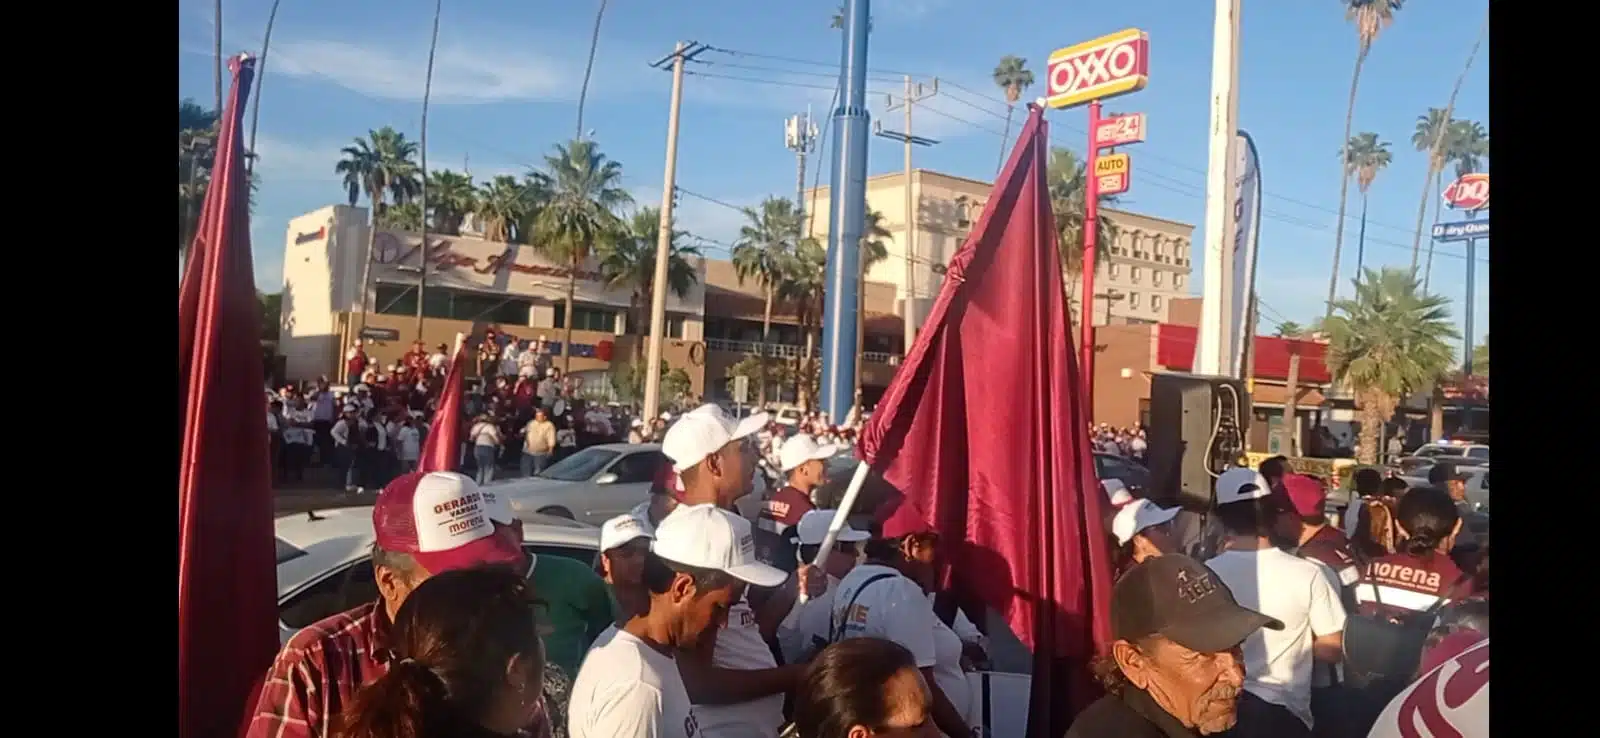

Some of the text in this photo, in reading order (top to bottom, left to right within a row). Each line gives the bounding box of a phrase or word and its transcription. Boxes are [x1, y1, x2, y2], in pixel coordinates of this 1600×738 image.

[1049, 43, 1136, 94] OXXO
[1116, 118, 1138, 134] 24
[1097, 158, 1124, 171] AUTO
[1455, 181, 1489, 202] DQ
[449, 515, 484, 534] morena
